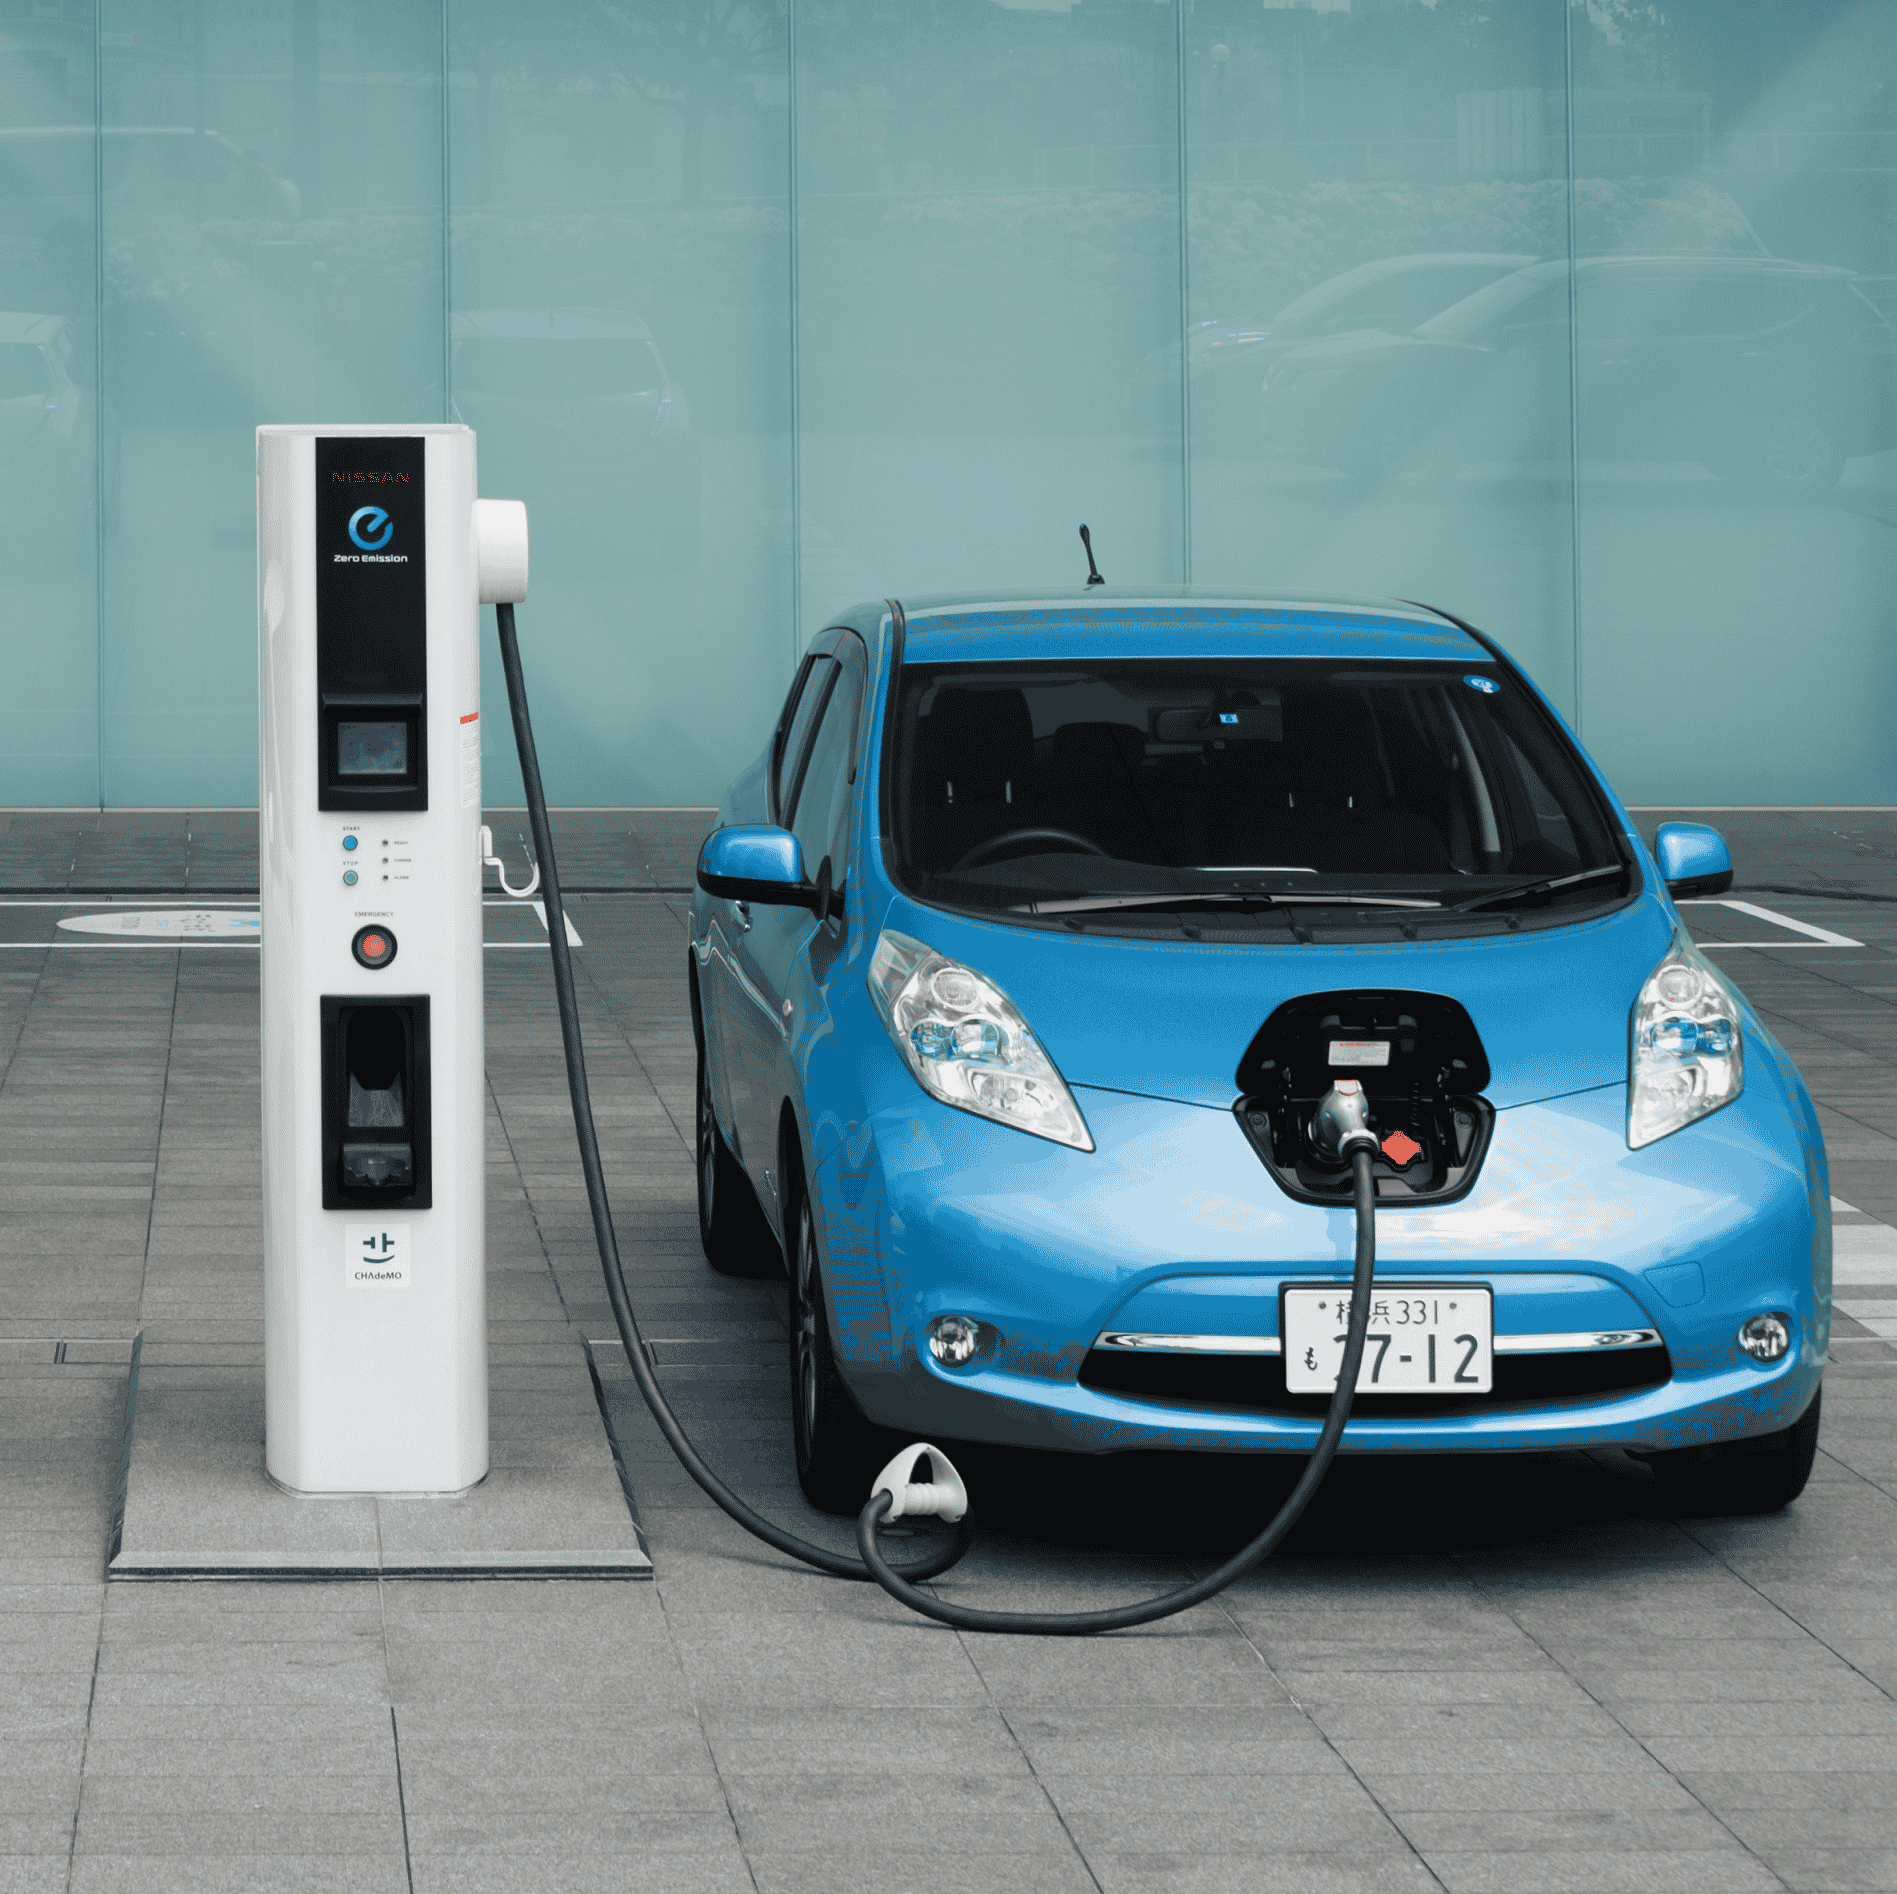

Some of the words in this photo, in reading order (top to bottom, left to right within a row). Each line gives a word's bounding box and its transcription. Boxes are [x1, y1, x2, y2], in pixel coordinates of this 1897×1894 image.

[331, 472, 410, 483] NISSAN
[333, 554, 360, 563] Zero
[361, 554, 409, 563] Emission
[354, 1271, 402, 1280] CHAdeMO
[1304, 1346, 1318, 1371] も
[1333, 1334, 1479, 1383] 7-12
